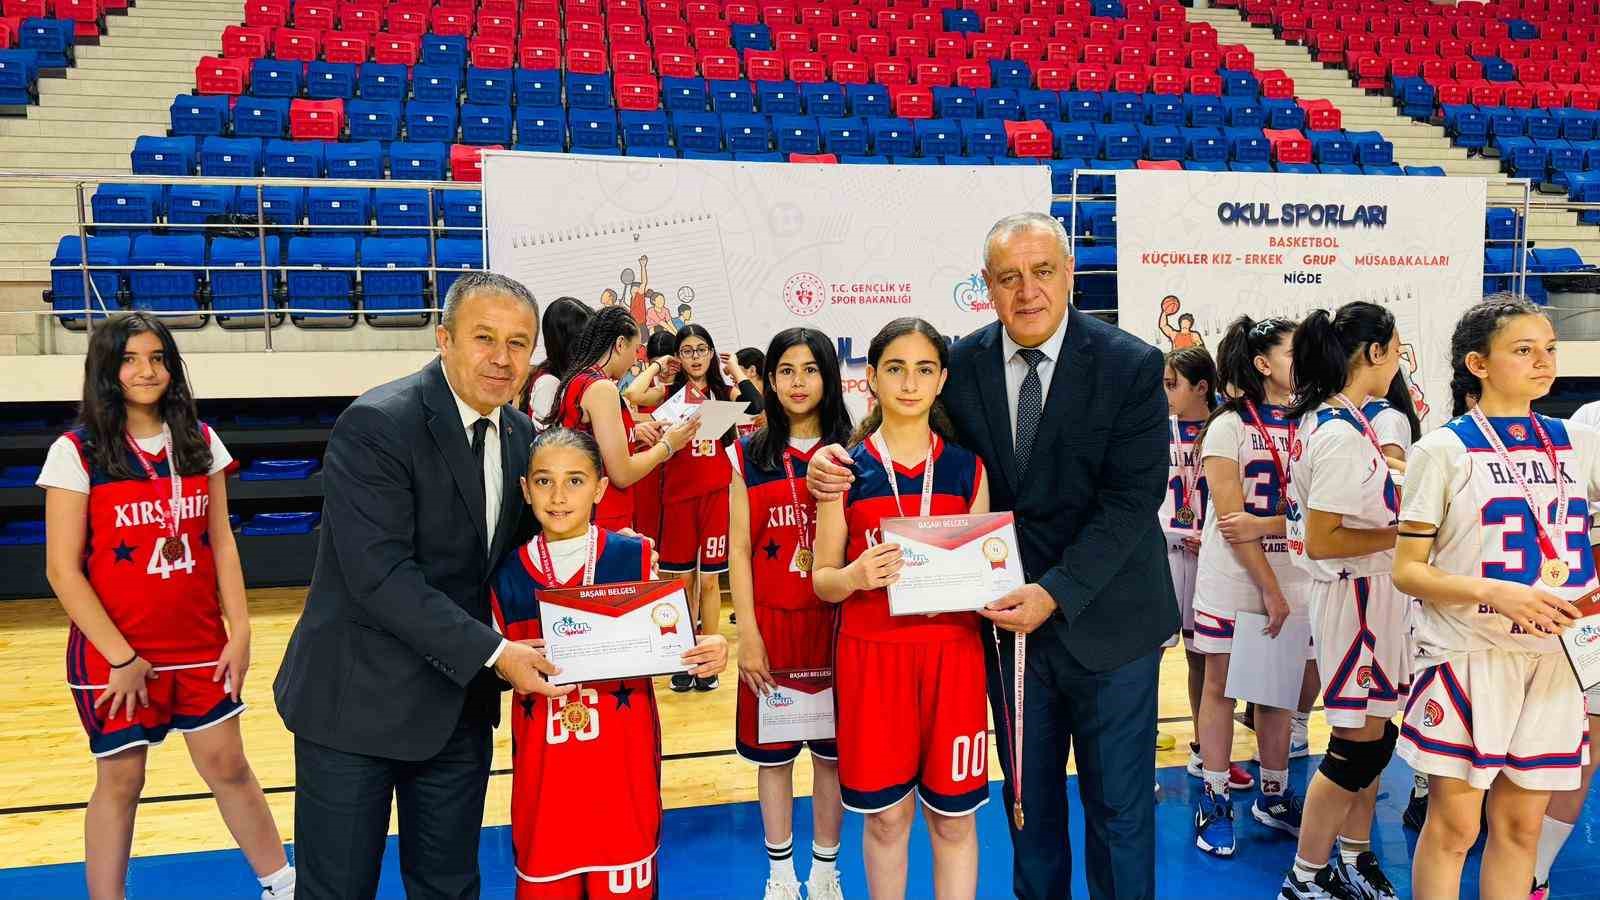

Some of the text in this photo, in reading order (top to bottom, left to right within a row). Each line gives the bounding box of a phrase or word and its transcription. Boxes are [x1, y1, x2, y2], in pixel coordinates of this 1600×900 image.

[1217, 201, 1388, 229] OKUL SPORLARI
[1268, 236, 1340, 248] BASKETBOL
[1141, 250, 1208, 267] KÜÇÜKLER
[1212, 252, 1233, 265] KIZ
[1244, 253, 1284, 265] ERKEK
[1302, 254, 1337, 265] GRUP
[1283, 271, 1322, 284] NİĞDE
[831, 281, 912, 295] T.C. GENÇLİK VE
[831, 294, 912, 305] SPOR BAKANLIĞI
[706, 535, 727, 558] 99
[1481, 496, 1597, 588] 33
[146, 533, 197, 580] 44
[579, 586, 636, 599] BAŞARI BELGESİ
[951, 730, 986, 782] 00
[1262, 780, 1281, 793] 23
